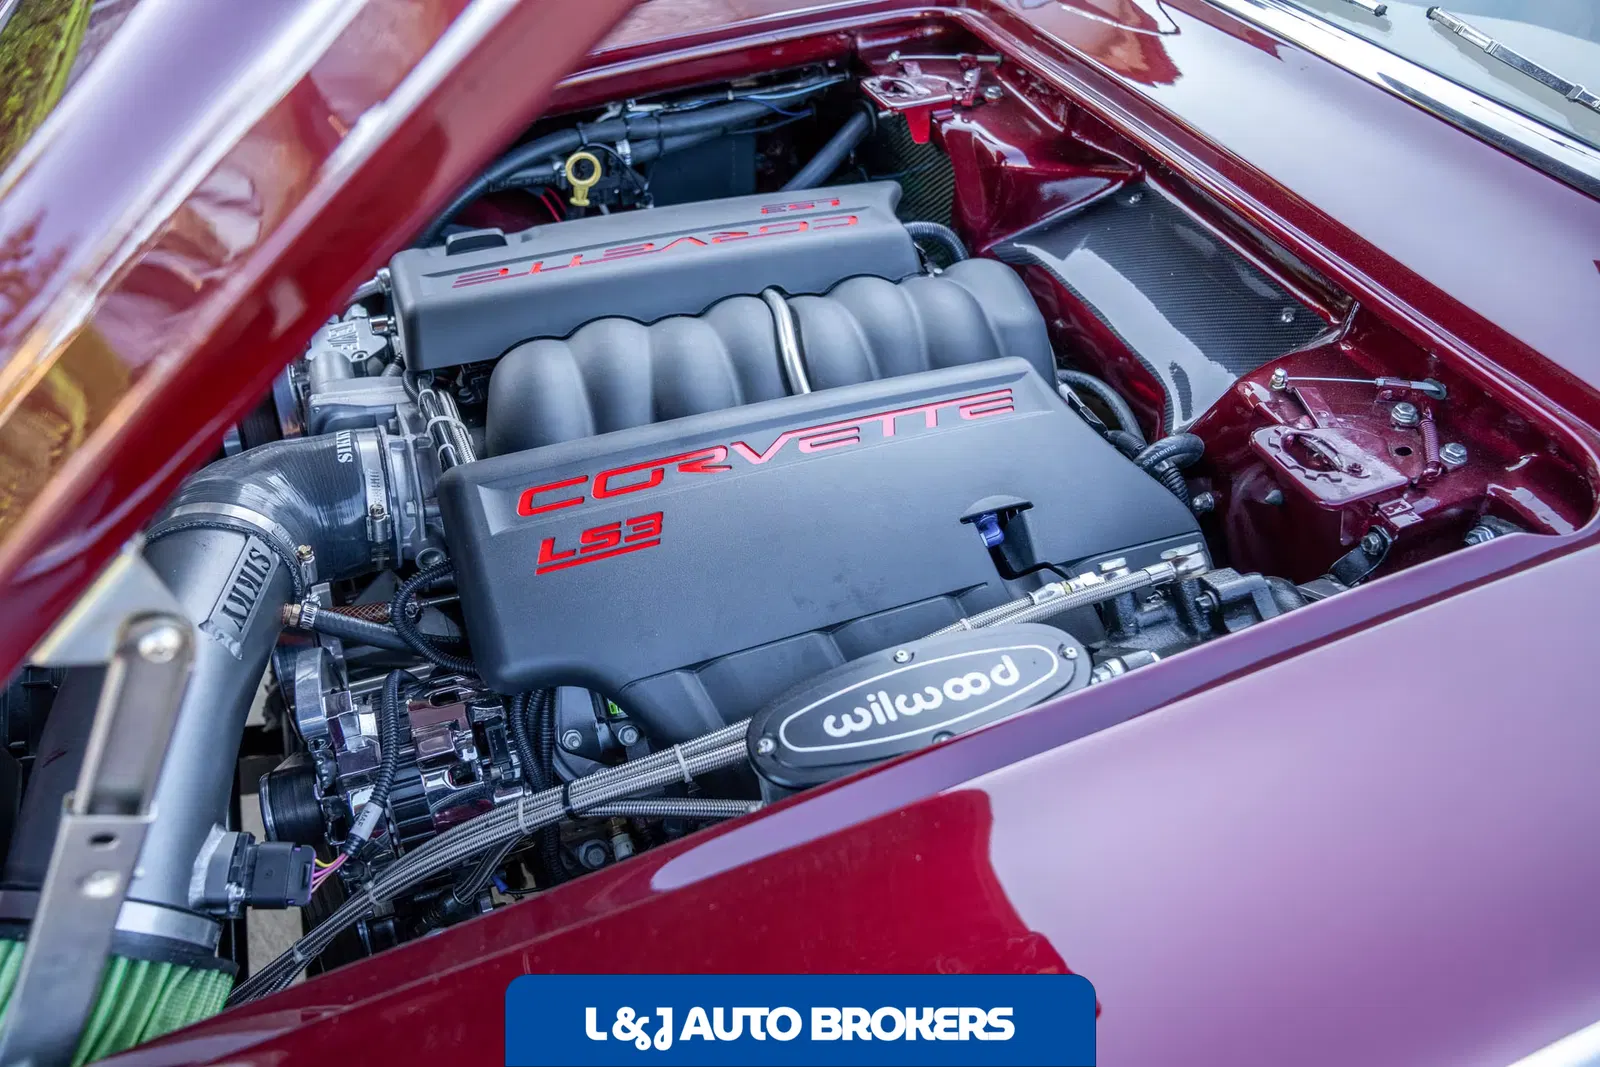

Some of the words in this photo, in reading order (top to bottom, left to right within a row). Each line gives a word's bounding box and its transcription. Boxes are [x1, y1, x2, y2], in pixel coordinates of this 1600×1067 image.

[761, 197, 840, 214] LS3
[452, 215, 858, 288] CORVETTE
[517, 388, 1015, 517] CORVETTE
[536, 511, 664, 573] LS3
[222, 547, 271, 632] SIKKY
[823, 654, 1020, 737] wilwood
